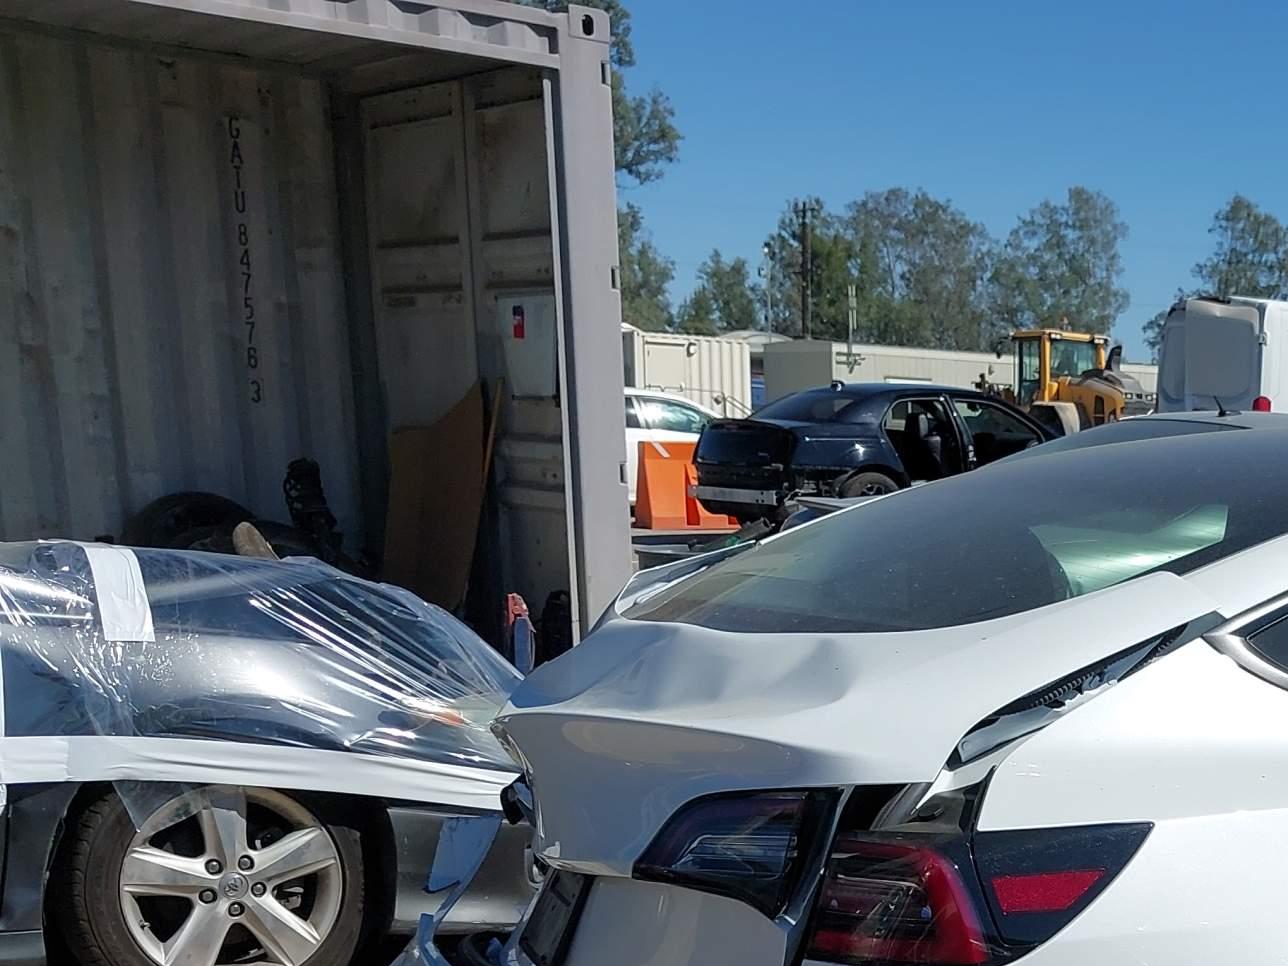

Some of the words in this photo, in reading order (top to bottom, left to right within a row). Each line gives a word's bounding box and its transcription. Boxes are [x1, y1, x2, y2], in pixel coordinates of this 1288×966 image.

[228, 116, 246, 213] GATU
[238, 223, 258, 369] 847576
[250, 380, 262, 403] 3
